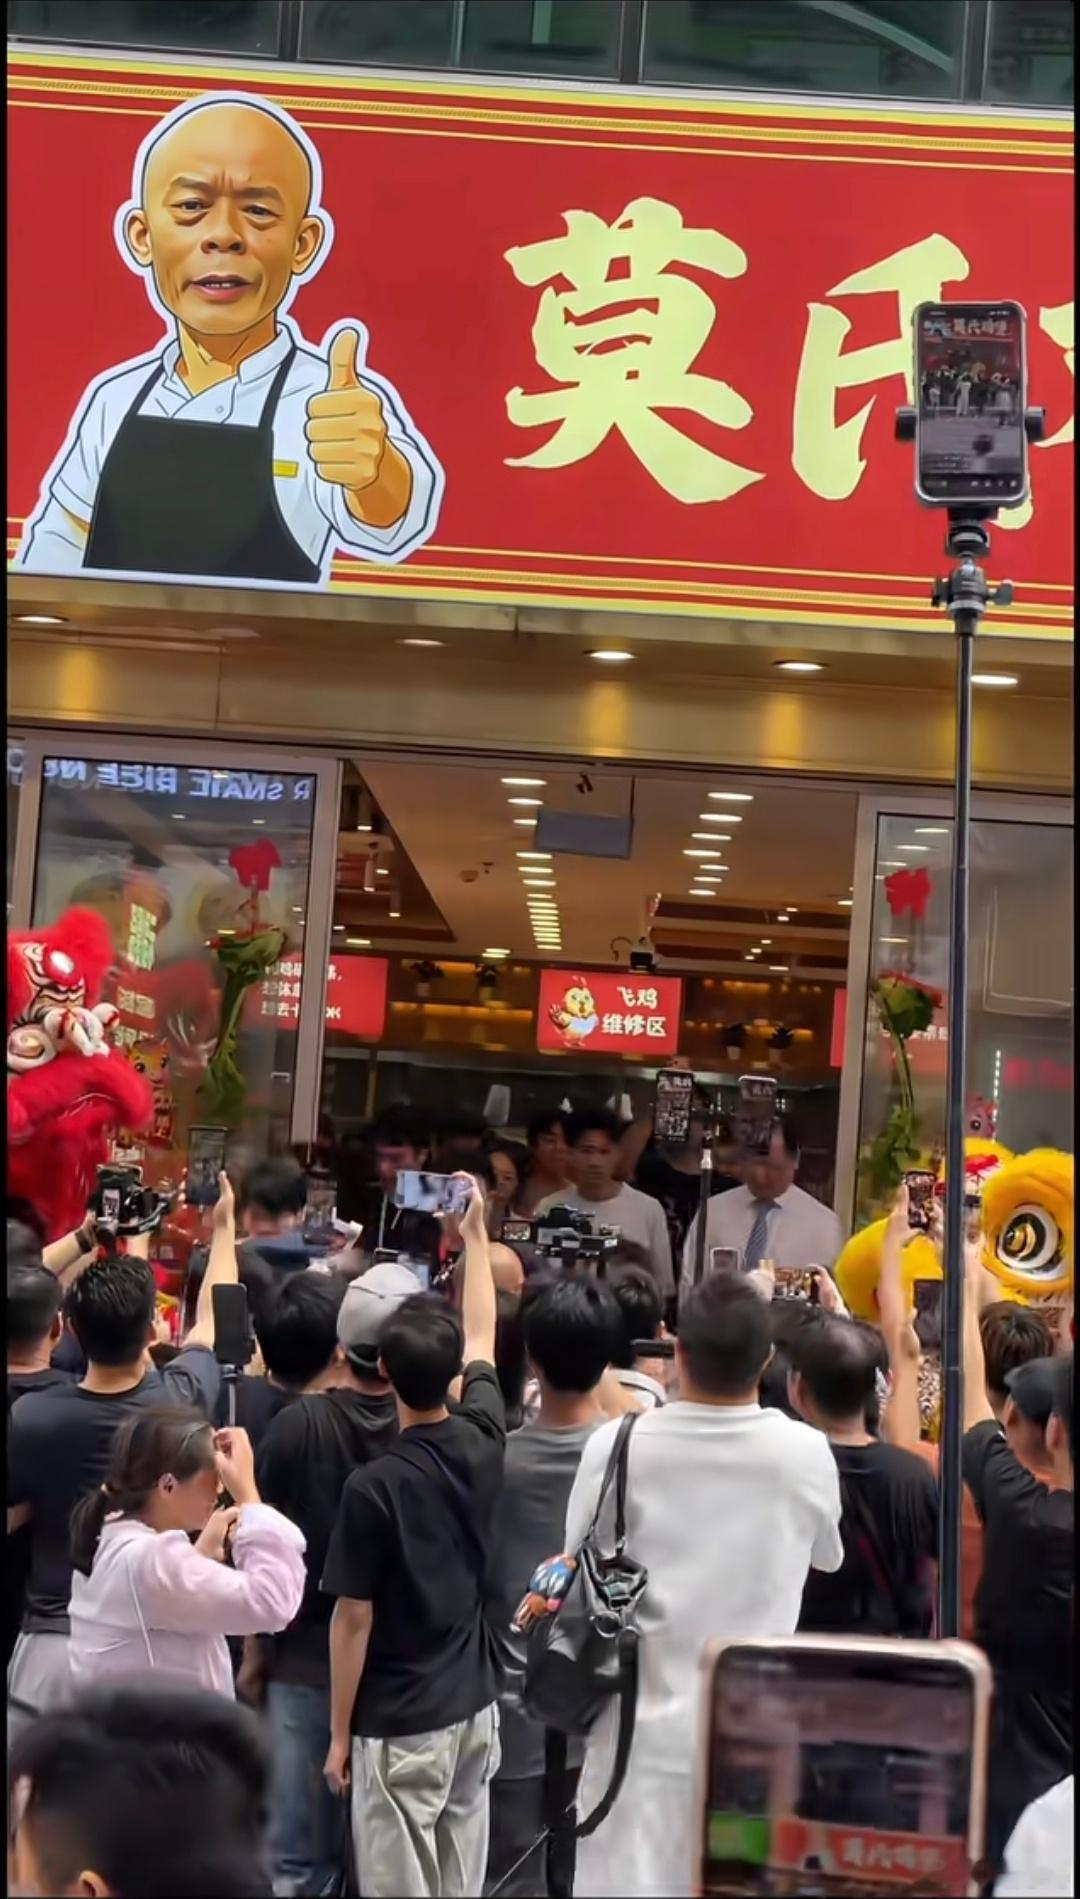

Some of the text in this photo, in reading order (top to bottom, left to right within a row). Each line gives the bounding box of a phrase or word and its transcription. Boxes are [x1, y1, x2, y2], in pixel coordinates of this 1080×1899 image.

[616, 985, 658, 1009] 飞鸡
[602, 1013, 667, 1037] 维修区
